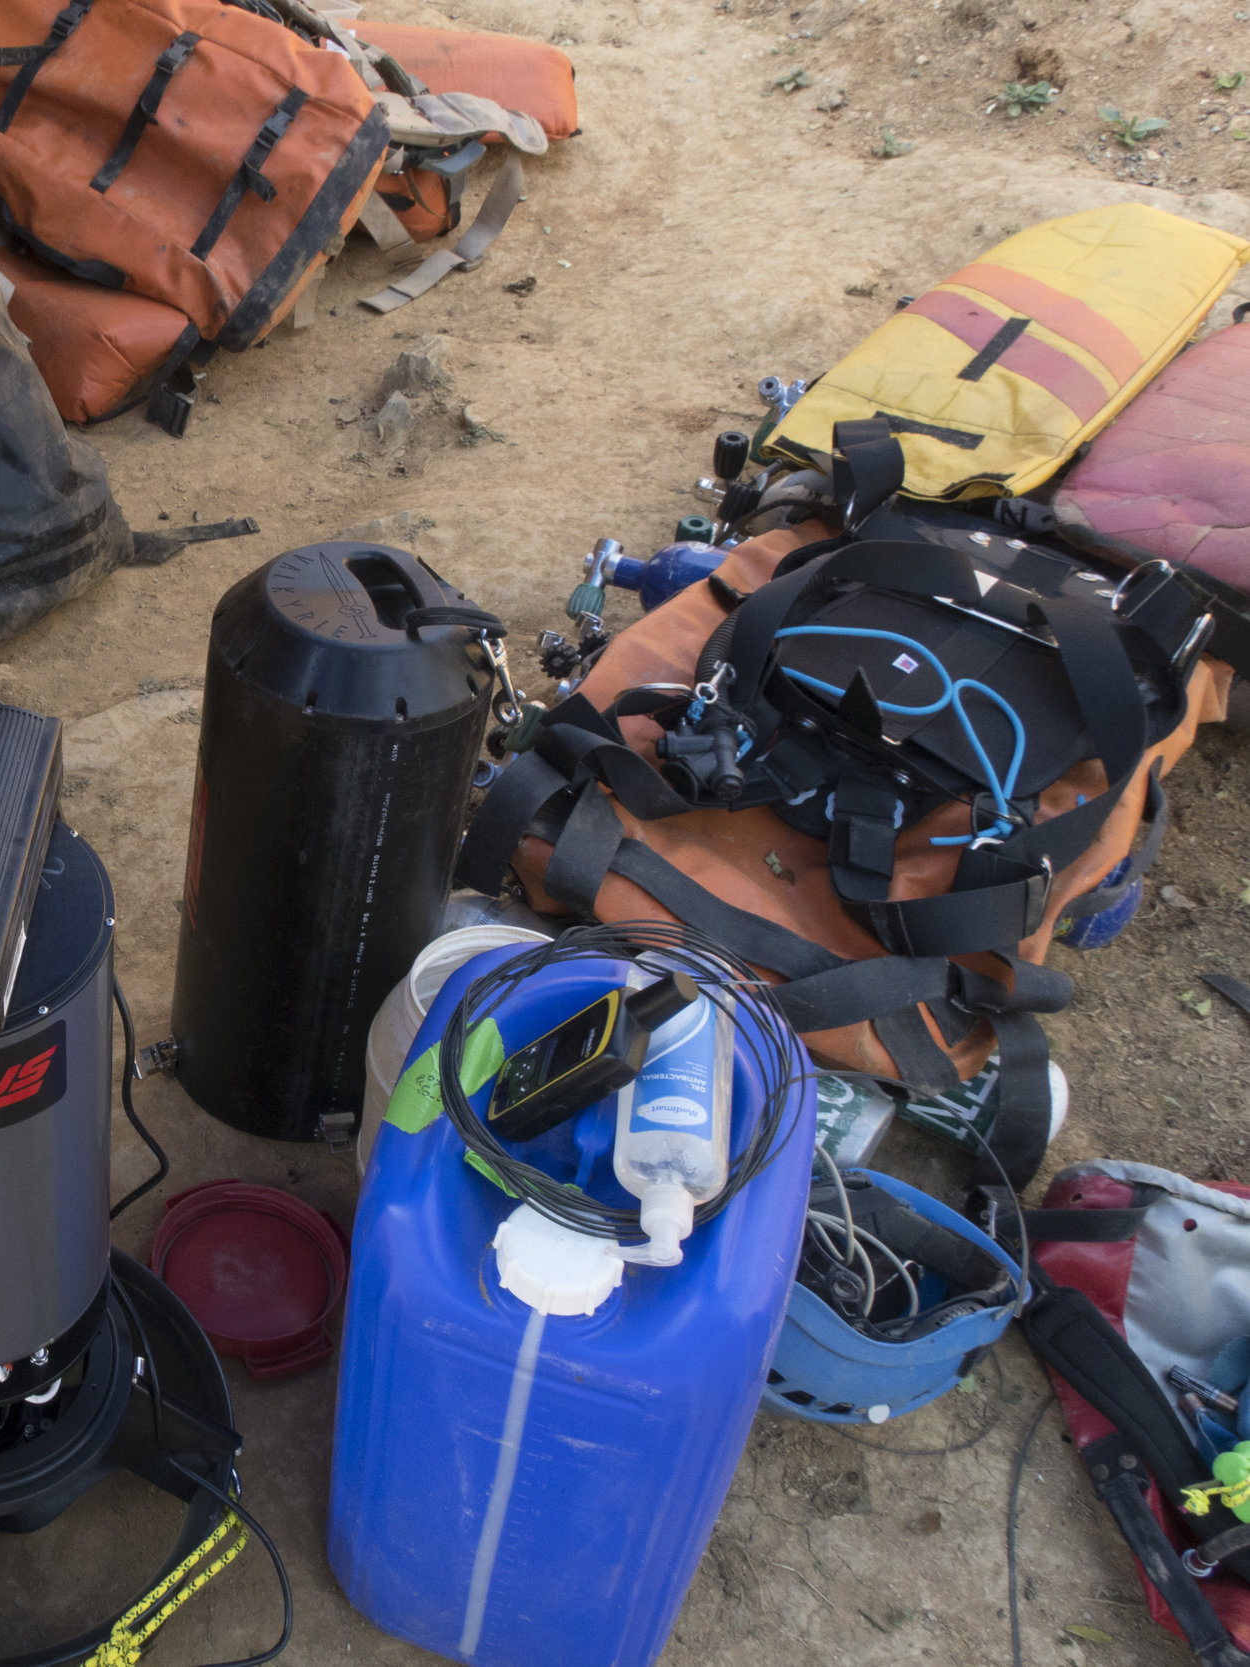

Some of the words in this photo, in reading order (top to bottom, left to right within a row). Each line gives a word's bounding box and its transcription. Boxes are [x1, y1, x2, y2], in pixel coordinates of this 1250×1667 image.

[641, 1073, 707, 1086] ANTIBACTERIAL
[690, 1083, 707, 1094] GEL
[651, 1104, 699, 1119] Medimart
